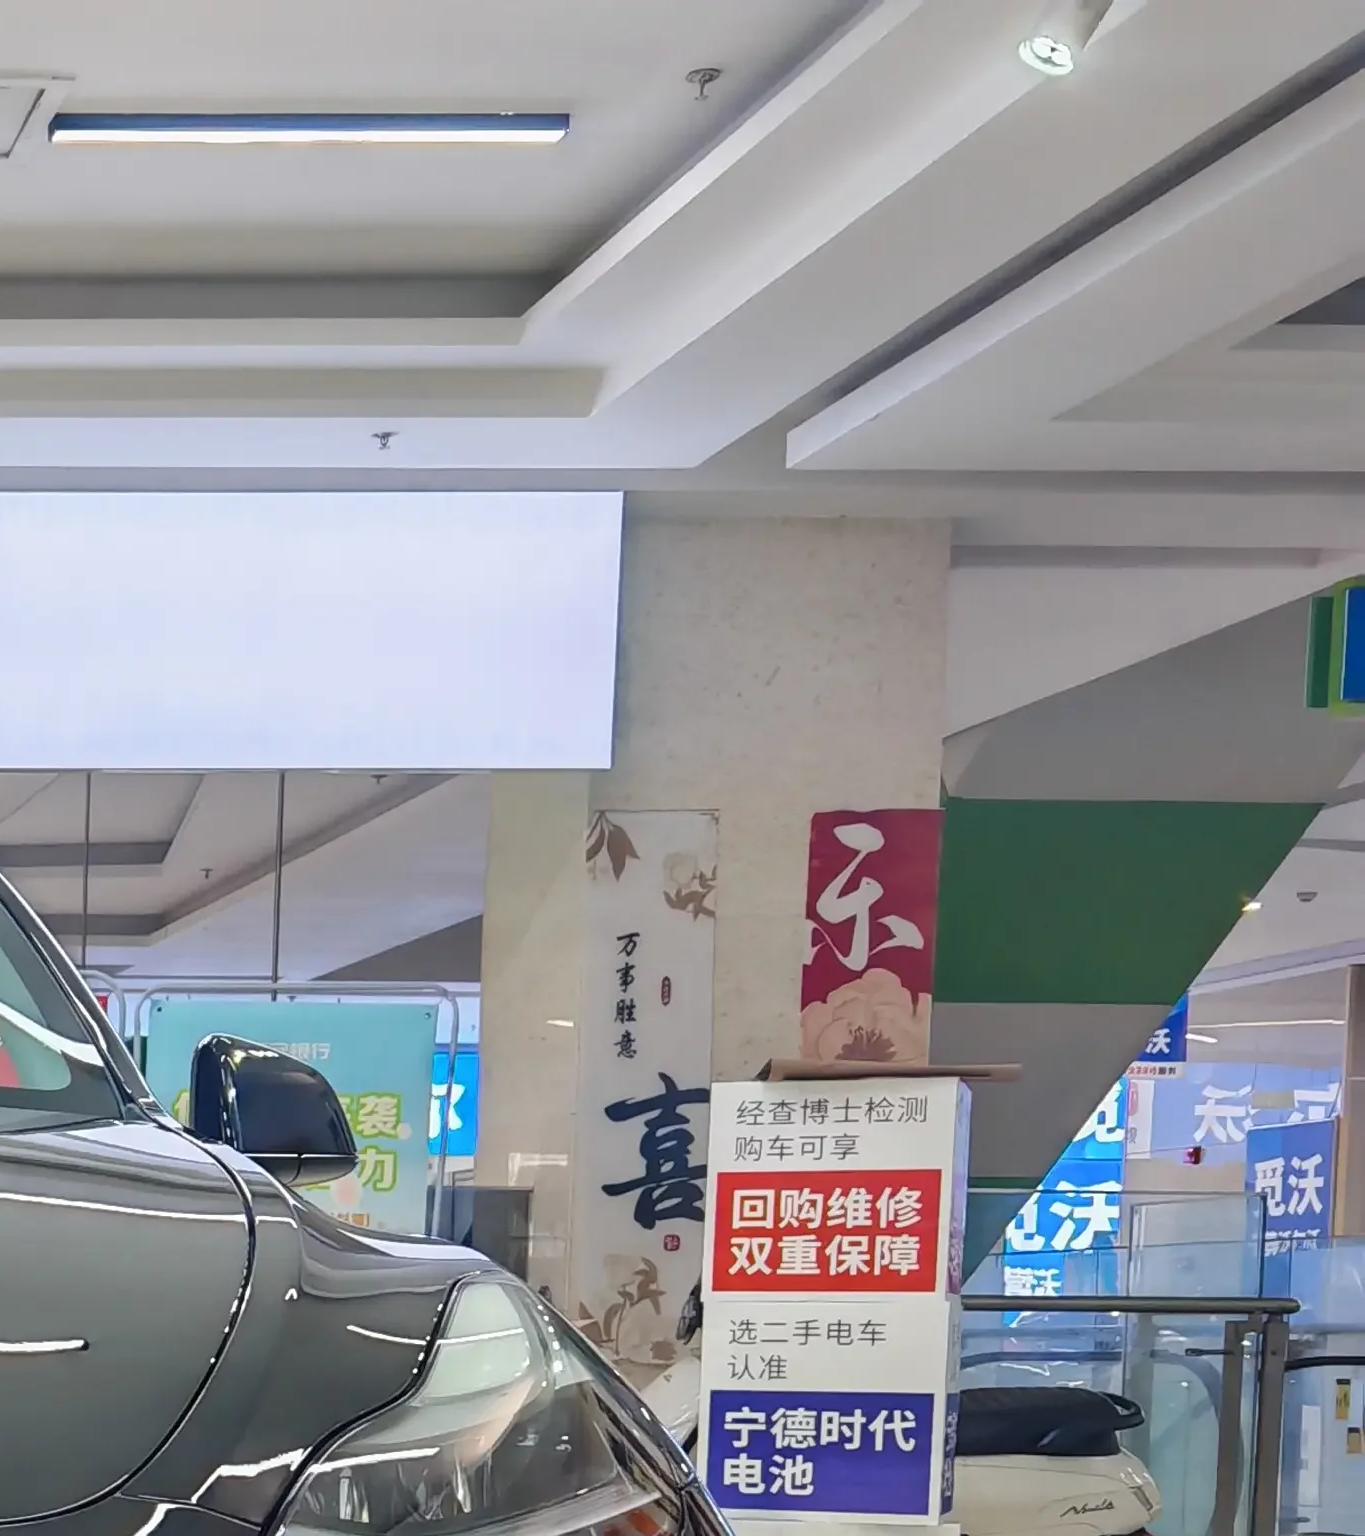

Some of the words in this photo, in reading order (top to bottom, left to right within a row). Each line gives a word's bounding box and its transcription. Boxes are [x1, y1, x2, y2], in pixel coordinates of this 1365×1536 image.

[802, 822, 925, 972] 乐
[614, 931, 641, 1059] 万事胜意
[735, 1095, 928, 1126] 经查博士检测
[600, 1071, 711, 1230] 喜
[733, 1133, 860, 1162] 购车可享
[731, 1186, 923, 1230] 回购维修
[728, 1234, 921, 1277] 双重保障
[728, 1319, 887, 1347] 选二手电车
[727, 1354, 787, 1381] 认准
[723, 1406, 917, 1452] 宁德时代
[723, 1453, 815, 1496] 电池
